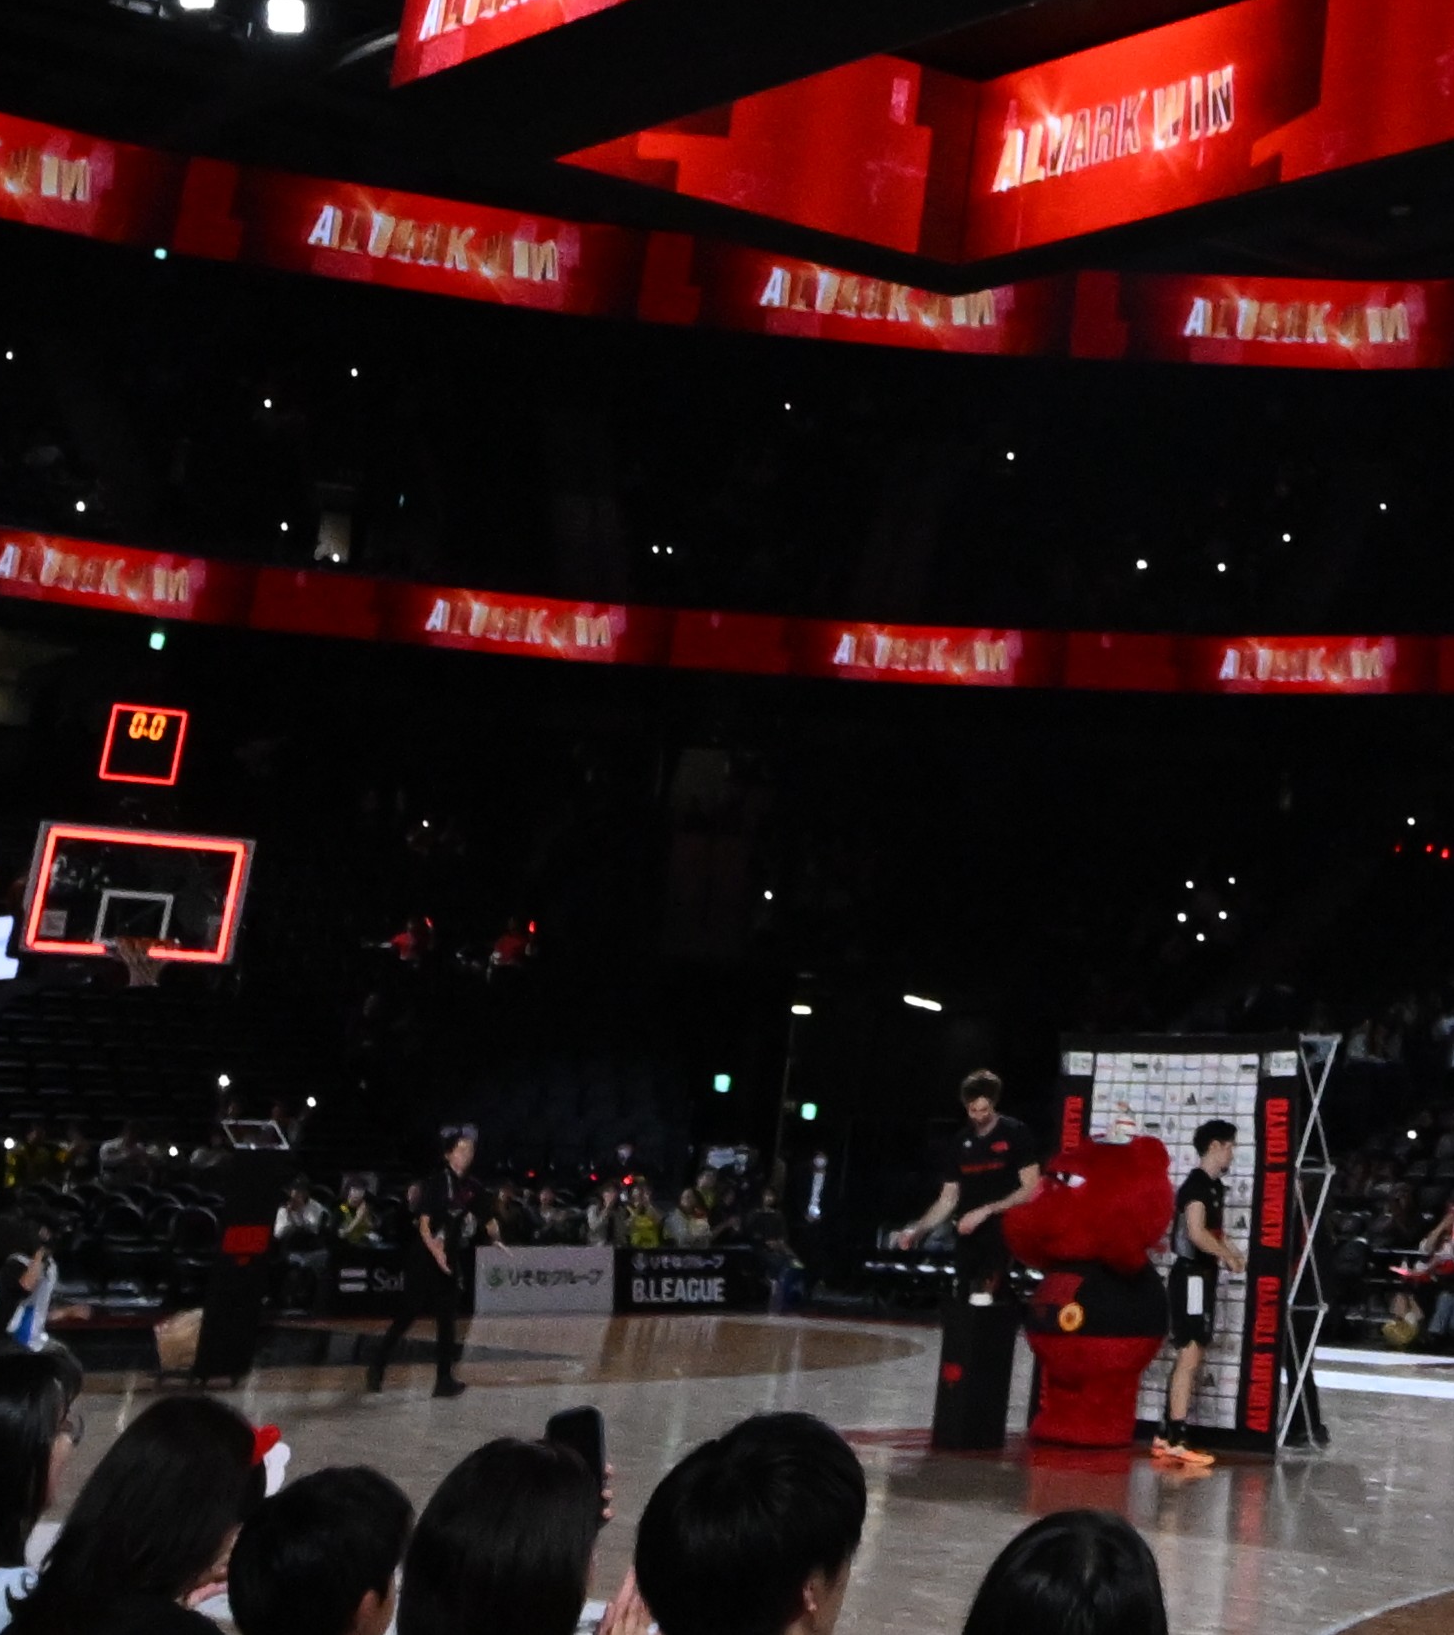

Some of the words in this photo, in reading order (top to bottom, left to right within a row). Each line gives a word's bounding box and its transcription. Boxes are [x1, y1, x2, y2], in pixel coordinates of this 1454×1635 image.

[990, 89, 1146, 193] ALVARK
[1152, 63, 1236, 151] WIN
[128, 711, 167, 742] 0.0
[631, 1275, 727, 1304] B.LEAGUE
